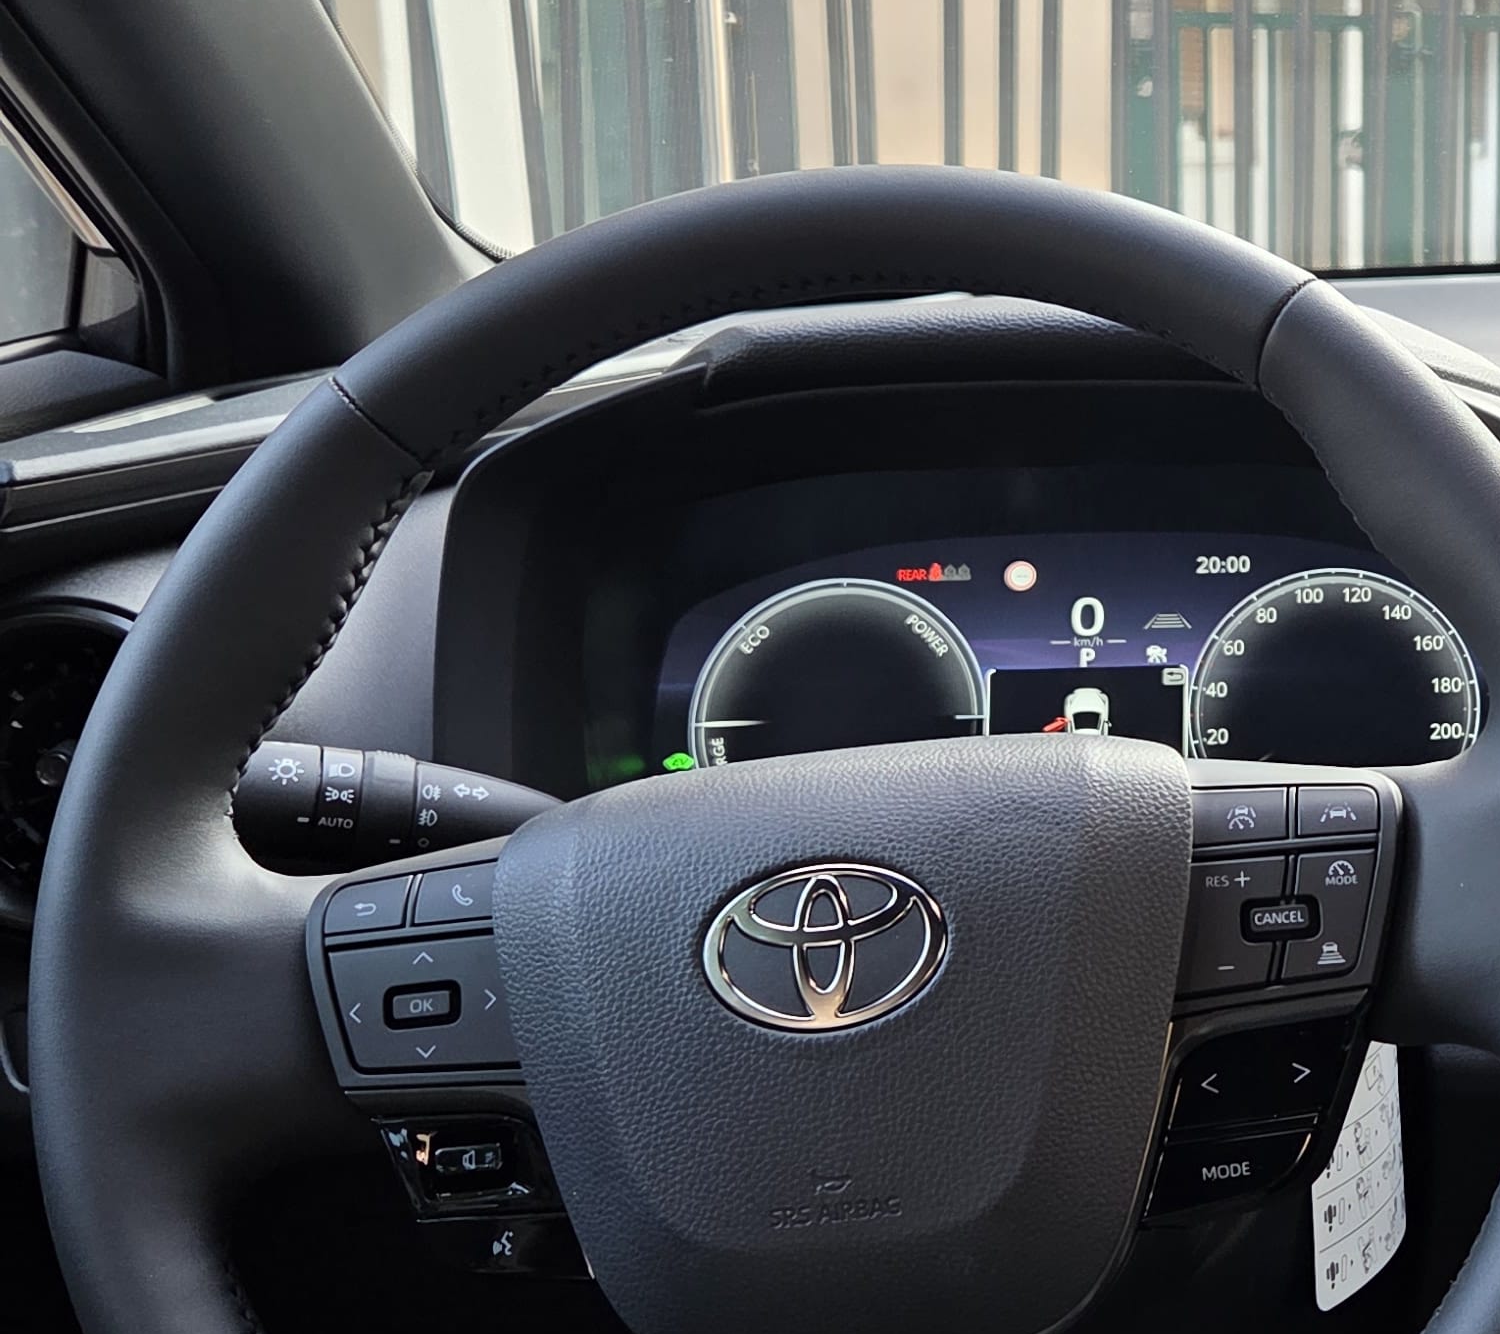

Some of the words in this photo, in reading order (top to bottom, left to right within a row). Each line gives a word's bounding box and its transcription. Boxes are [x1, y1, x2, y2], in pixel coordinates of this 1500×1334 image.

[1196, 555, 1251, 574] 20:00
[897, 568, 927, 581] REAR
[1294, 587, 1323, 604] 100
[1343, 586, 1372, 603] 120
[1071, 596, 1105, 637] 0
[1255, 607, 1278, 624] 80
[1382, 604, 1412, 621] 140
[739, 623, 771, 655] ECO
[904, 612, 950, 658] POWER
[1073, 637, 1105, 648] km/h
[1413, 634, 1443, 651] 160
[1223, 639, 1245, 656] 60
[1079, 648, 1096, 667] P
[1206, 681, 1228, 698] 40
[1431, 677, 1461, 693] 180
[1206, 728, 1229, 745] 20
[1429, 723, 1461, 740] 200
[317, 815, 354, 830] AUTO
[1204, 874, 1230, 889] RES
[1325, 874, 1358, 885] MODE
[1253, 910, 1305, 926] CANCEL
[408, 997, 434, 1014] OK
[1201, 1161, 1251, 1181] MODE
[768, 1206, 812, 1229] SRS
[817, 1197, 902, 1224] AIRBAG
